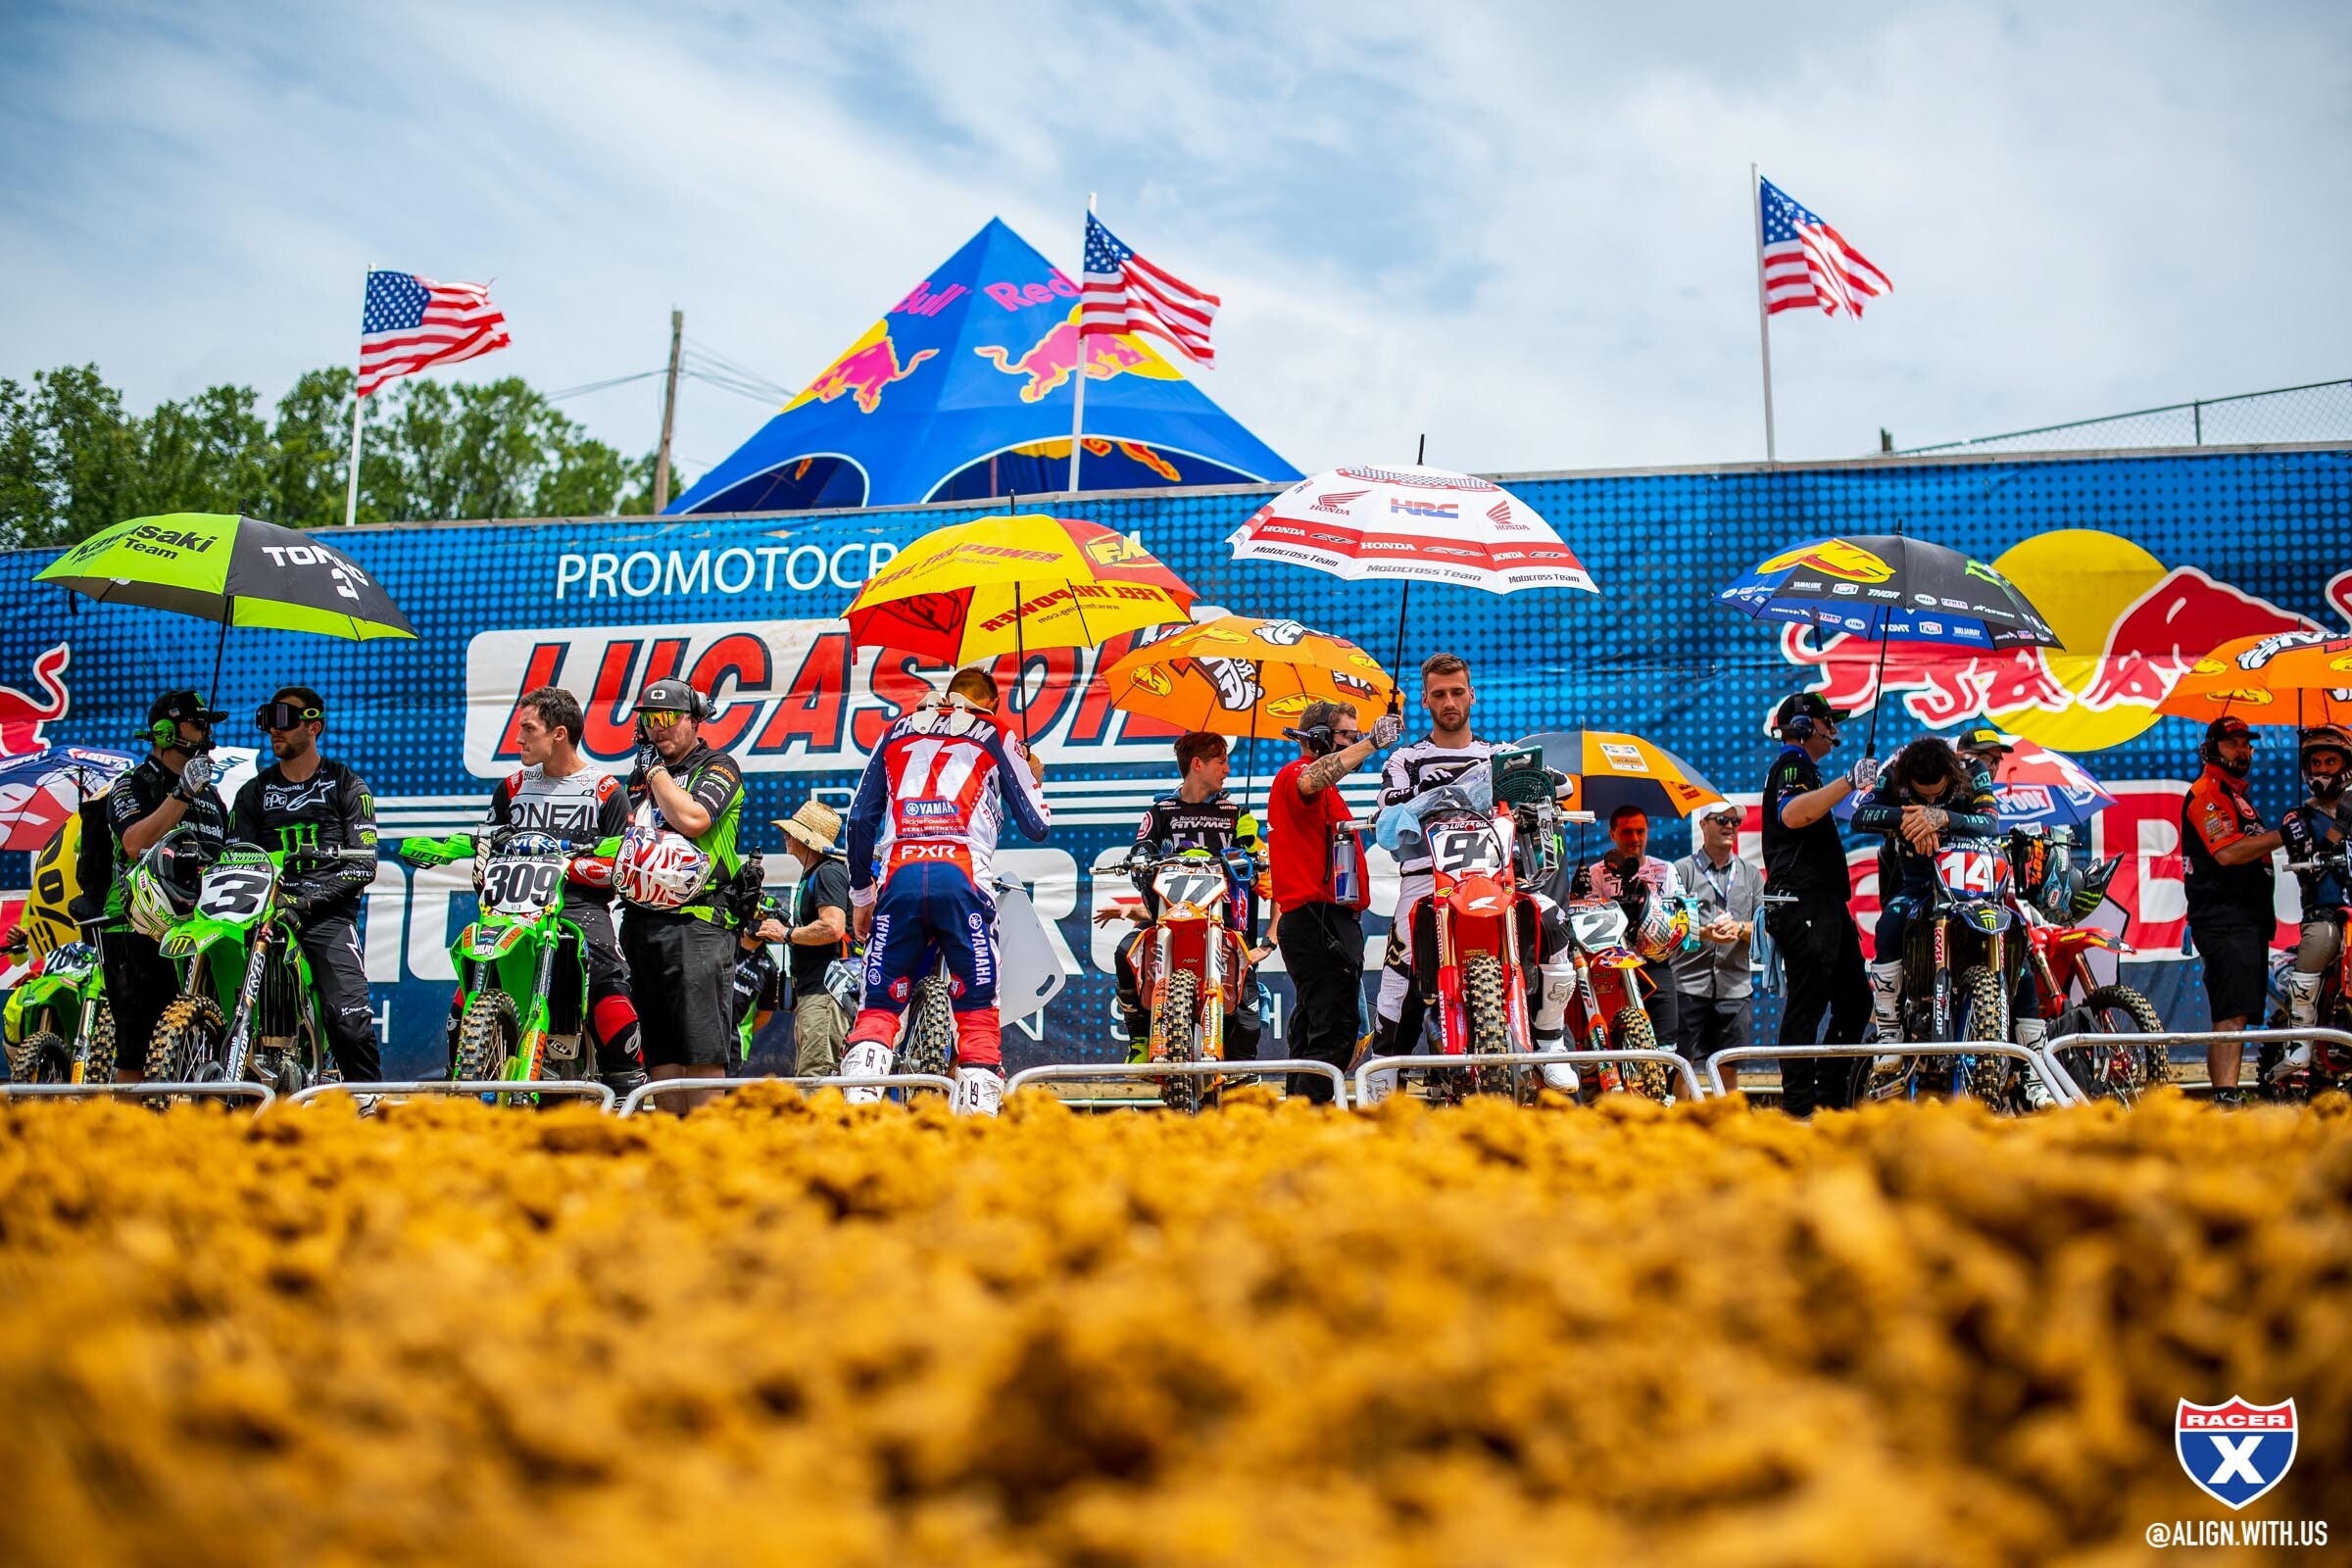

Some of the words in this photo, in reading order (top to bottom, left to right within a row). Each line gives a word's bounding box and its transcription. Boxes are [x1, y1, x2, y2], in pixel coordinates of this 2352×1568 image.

[984, 268, 1083, 312] Red
[1308, 504, 1351, 516] HONDA
[1390, 497, 1459, 518] HRC
[1261, 525, 1306, 537] HONDA
[1495, 522, 1531, 531] HONDA
[123, 538, 179, 561] Team
[957, 543, 1063, 564] POWER
[1252, 545, 1310, 561] Motocross
[1311, 554, 1340, 567] Team
[1360, 541, 1417, 551] HONDA
[1492, 551, 1526, 562] HONDA
[331, 566, 360, 601] 3
[1366, 564, 1442, 576] Motocross
[1443, 568, 1483, 582] Team
[1508, 574, 1554, 584] Motocross
[1554, 573, 1581, 583] Team
[1867, 588, 1900, 599] THOR
[491, 631, 960, 762] LUCAS
[212, 755, 249, 785] UZUKI
[896, 737, 985, 802] 11
[1974, 772, 1990, 786] MX
[266, 783, 305, 792] Kawasaki
[265, 794, 286, 808] PPG
[410, 850, 441, 862] UFO
[901, 845, 956, 861] FXR
[1956, 843, 1979, 852] LUCAS
[1940, 851, 1993, 893] 14
[2030, 838, 2044, 886] 100%
[201, 872, 270, 916] 3
[486, 863, 562, 908] 309
[1163, 874, 1222, 905] 17
[1582, 912, 1618, 946] 2
[472, 945, 495, 956] BLUD
[870, 913, 891, 968] YAMAHA
[971, 929, 991, 986] YAMAHA
[896, 989, 908, 998] DIV
[1439, 990, 1448, 1048] DUNLOP
